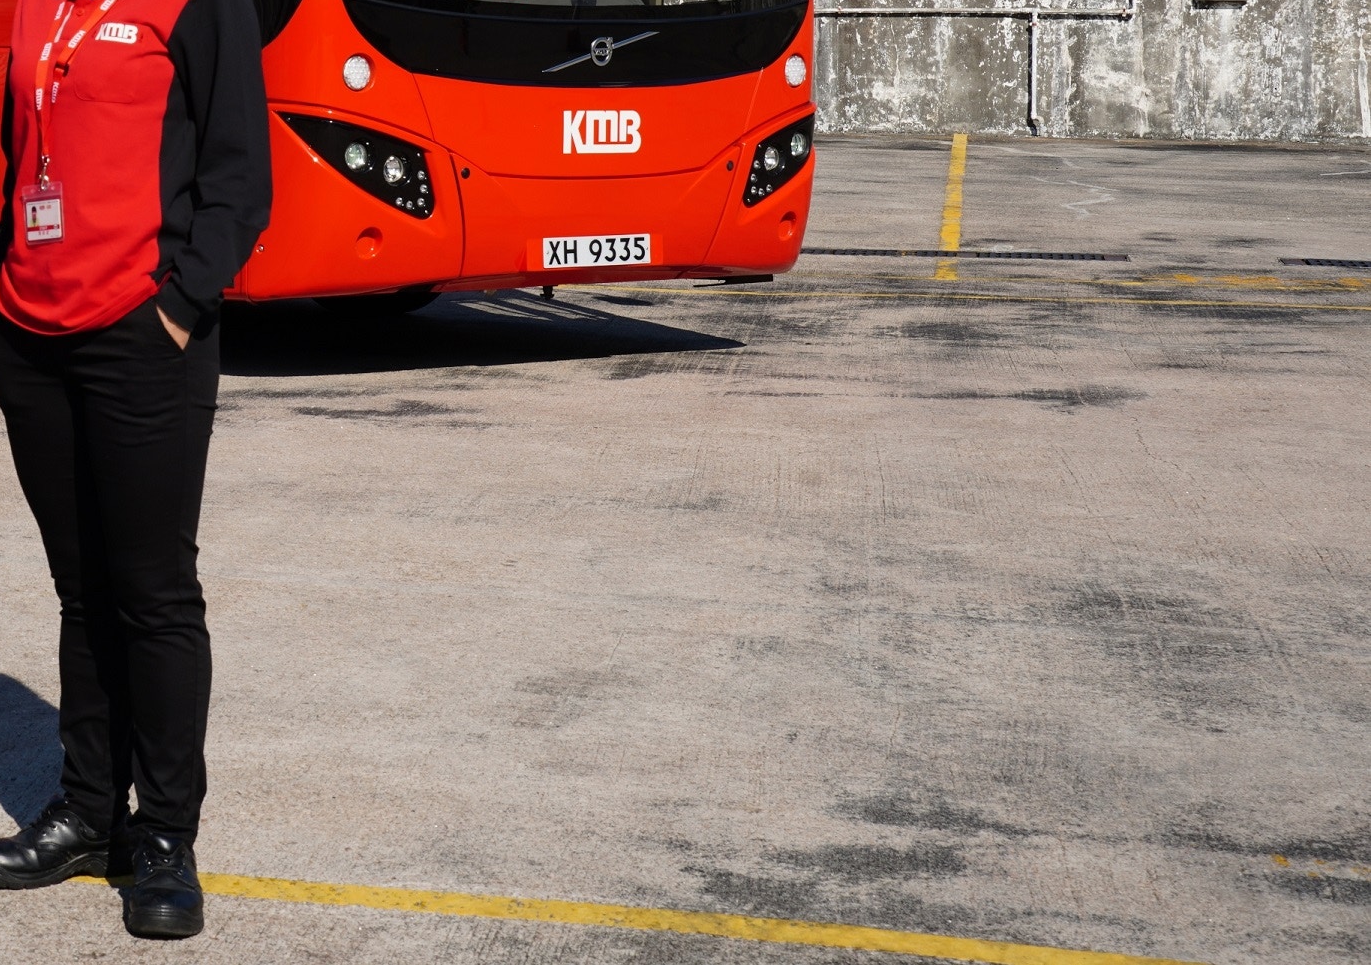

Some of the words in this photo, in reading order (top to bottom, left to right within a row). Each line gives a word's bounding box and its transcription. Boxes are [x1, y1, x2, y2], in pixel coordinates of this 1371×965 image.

[95, 22, 138, 44] KMB
[562, 110, 642, 154] KMB
[549, 240, 578, 265] XH
[589, 237, 646, 263] 9335
